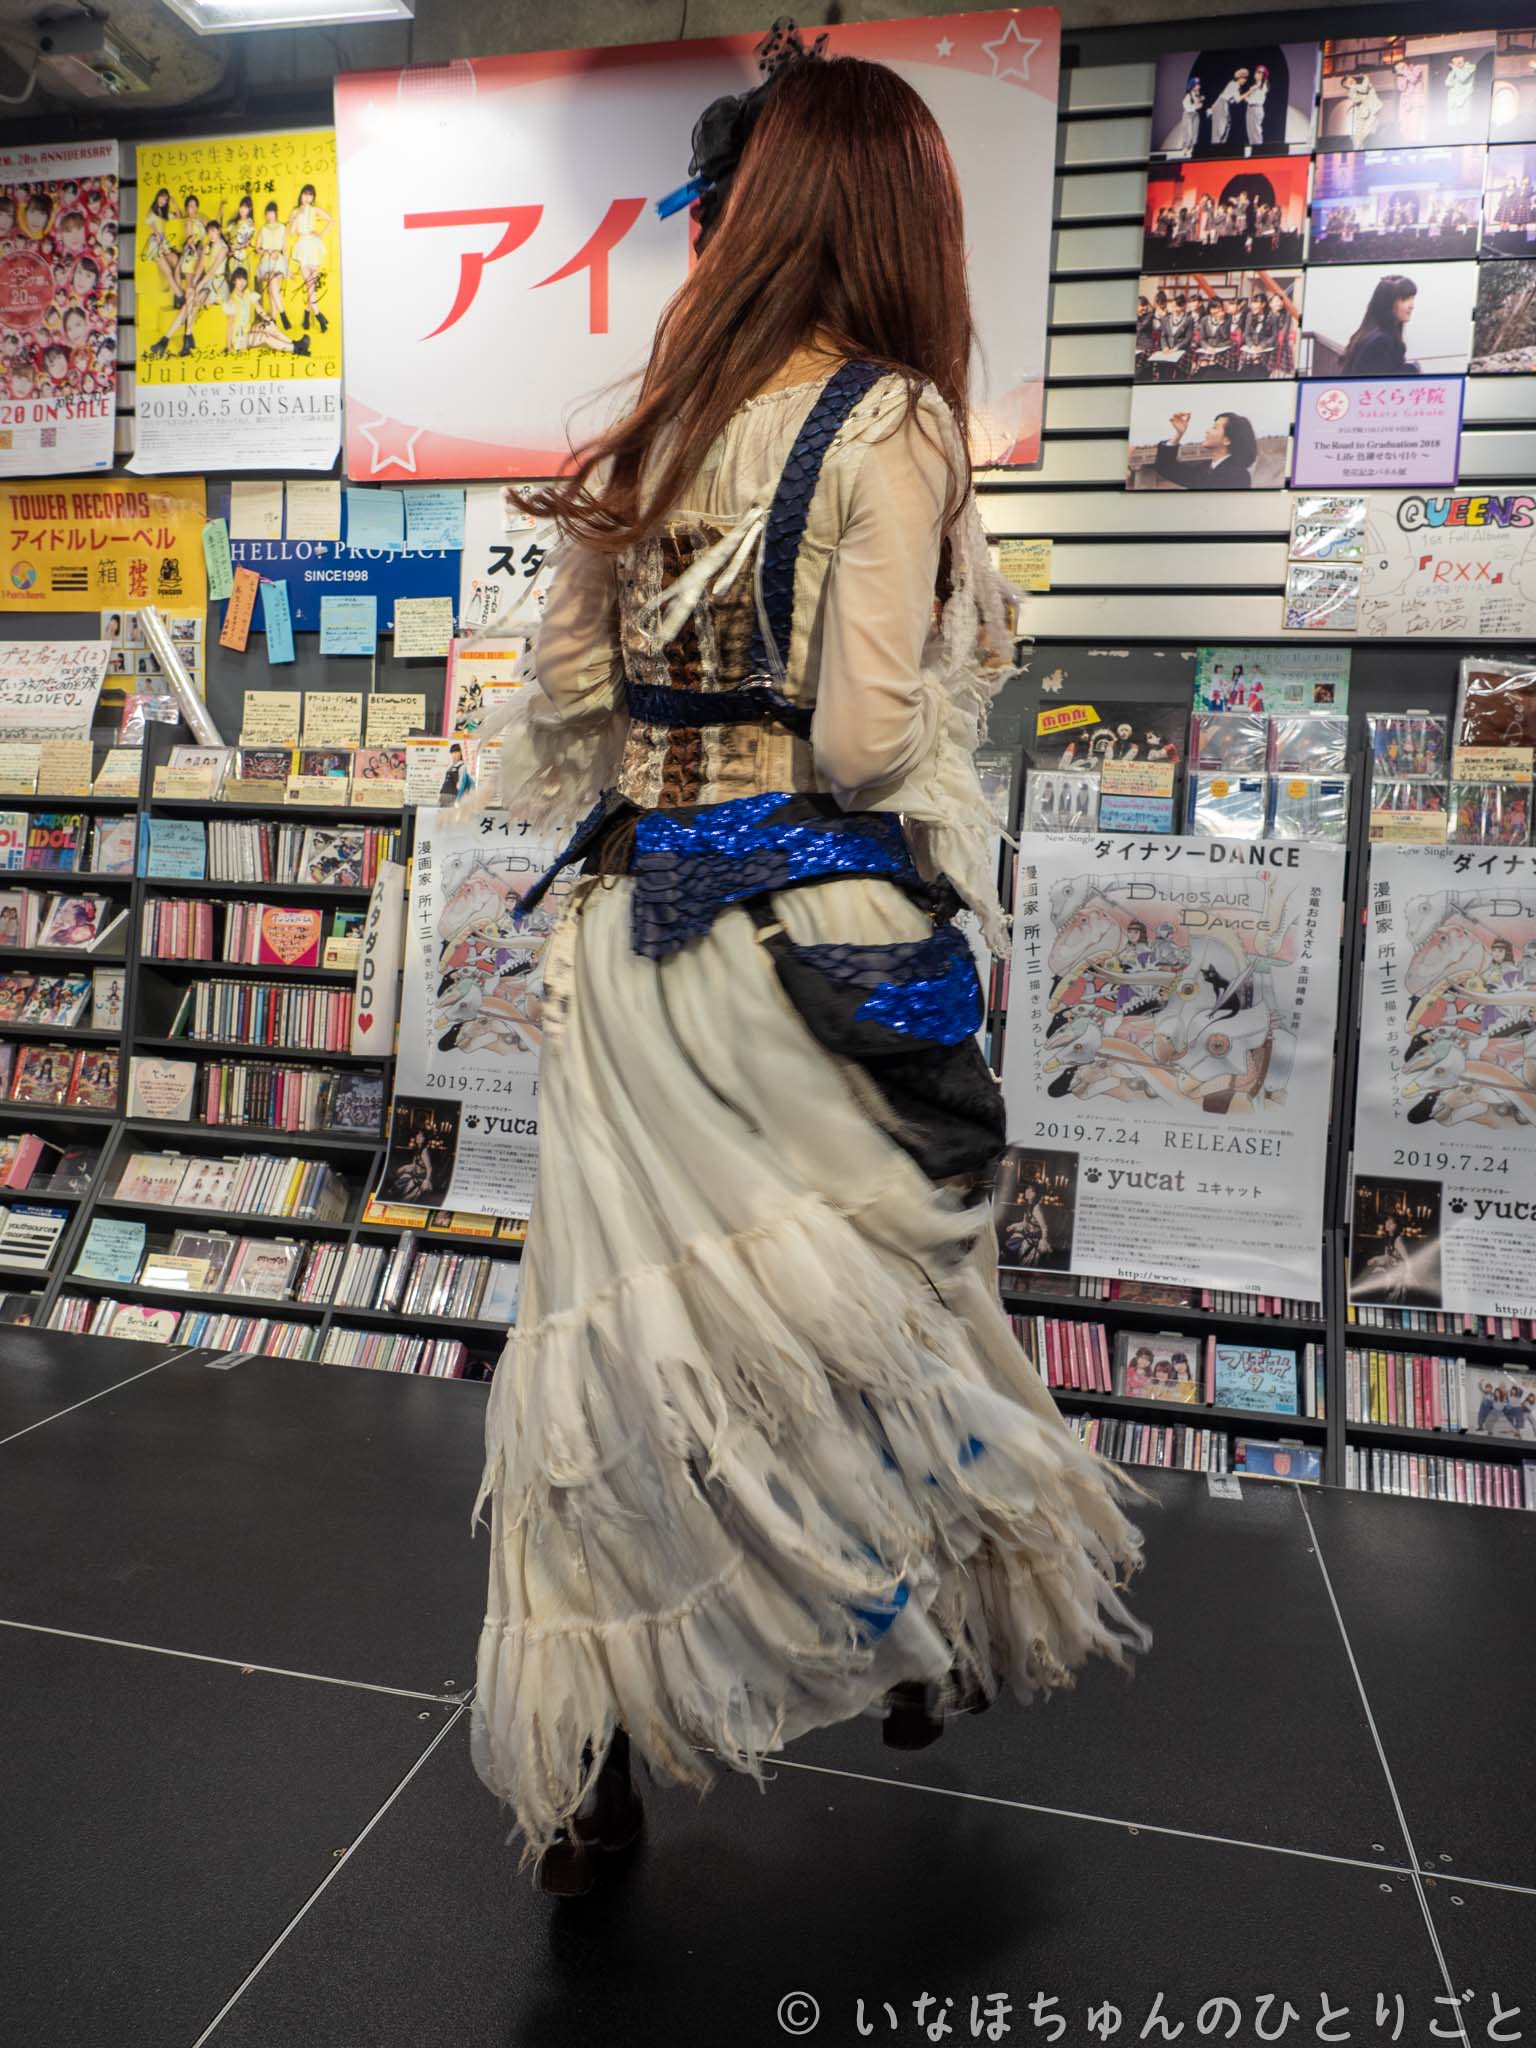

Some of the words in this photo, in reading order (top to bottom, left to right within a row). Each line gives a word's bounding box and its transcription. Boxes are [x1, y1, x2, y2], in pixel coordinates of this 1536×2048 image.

[403, 198, 702, 343] アイ
[187, 384, 221, 398] New
[228, 382, 286, 396] Single
[1358, 387, 1446, 406] さくら学院
[33, 402, 58, 421] ON
[65, 398, 110, 420] SALE
[140, 399, 231, 419] 2019.6.5
[240, 397, 271, 415] ON
[278, 394, 337, 414] SALE
[8, 493, 69, 521] TOWER
[73, 491, 151, 520] RECORDS
[1397, 495, 1536, 533] QUEENS
[10, 527, 177, 551] アイドルレーベル
[304, 569, 369, 583] SINCE1998
[417, 840, 433, 887] 漫画家
[1093, 840, 1301, 869] ダイナソーDANCE
[1452, 853, 1536, 875] ダイナ
[1021, 865, 1039, 917] 漫画家
[417, 893, 434, 941] 所十三
[1372, 881, 1394, 935] 漫画家
[1023, 924, 1043, 976] 所十三
[1377, 943, 1399, 996] 所十三
[426, 1073, 513, 1095] 2019.7.24
[1035, 1121, 1142, 1146] 2019.7.24
[1163, 1130, 1282, 1158] RELEASE!
[1393, 1149, 1510, 1175] 2019.7.24
[1107, 1169, 1185, 1193] yucat
[1196, 1181, 1263, 1199] ユキャット
